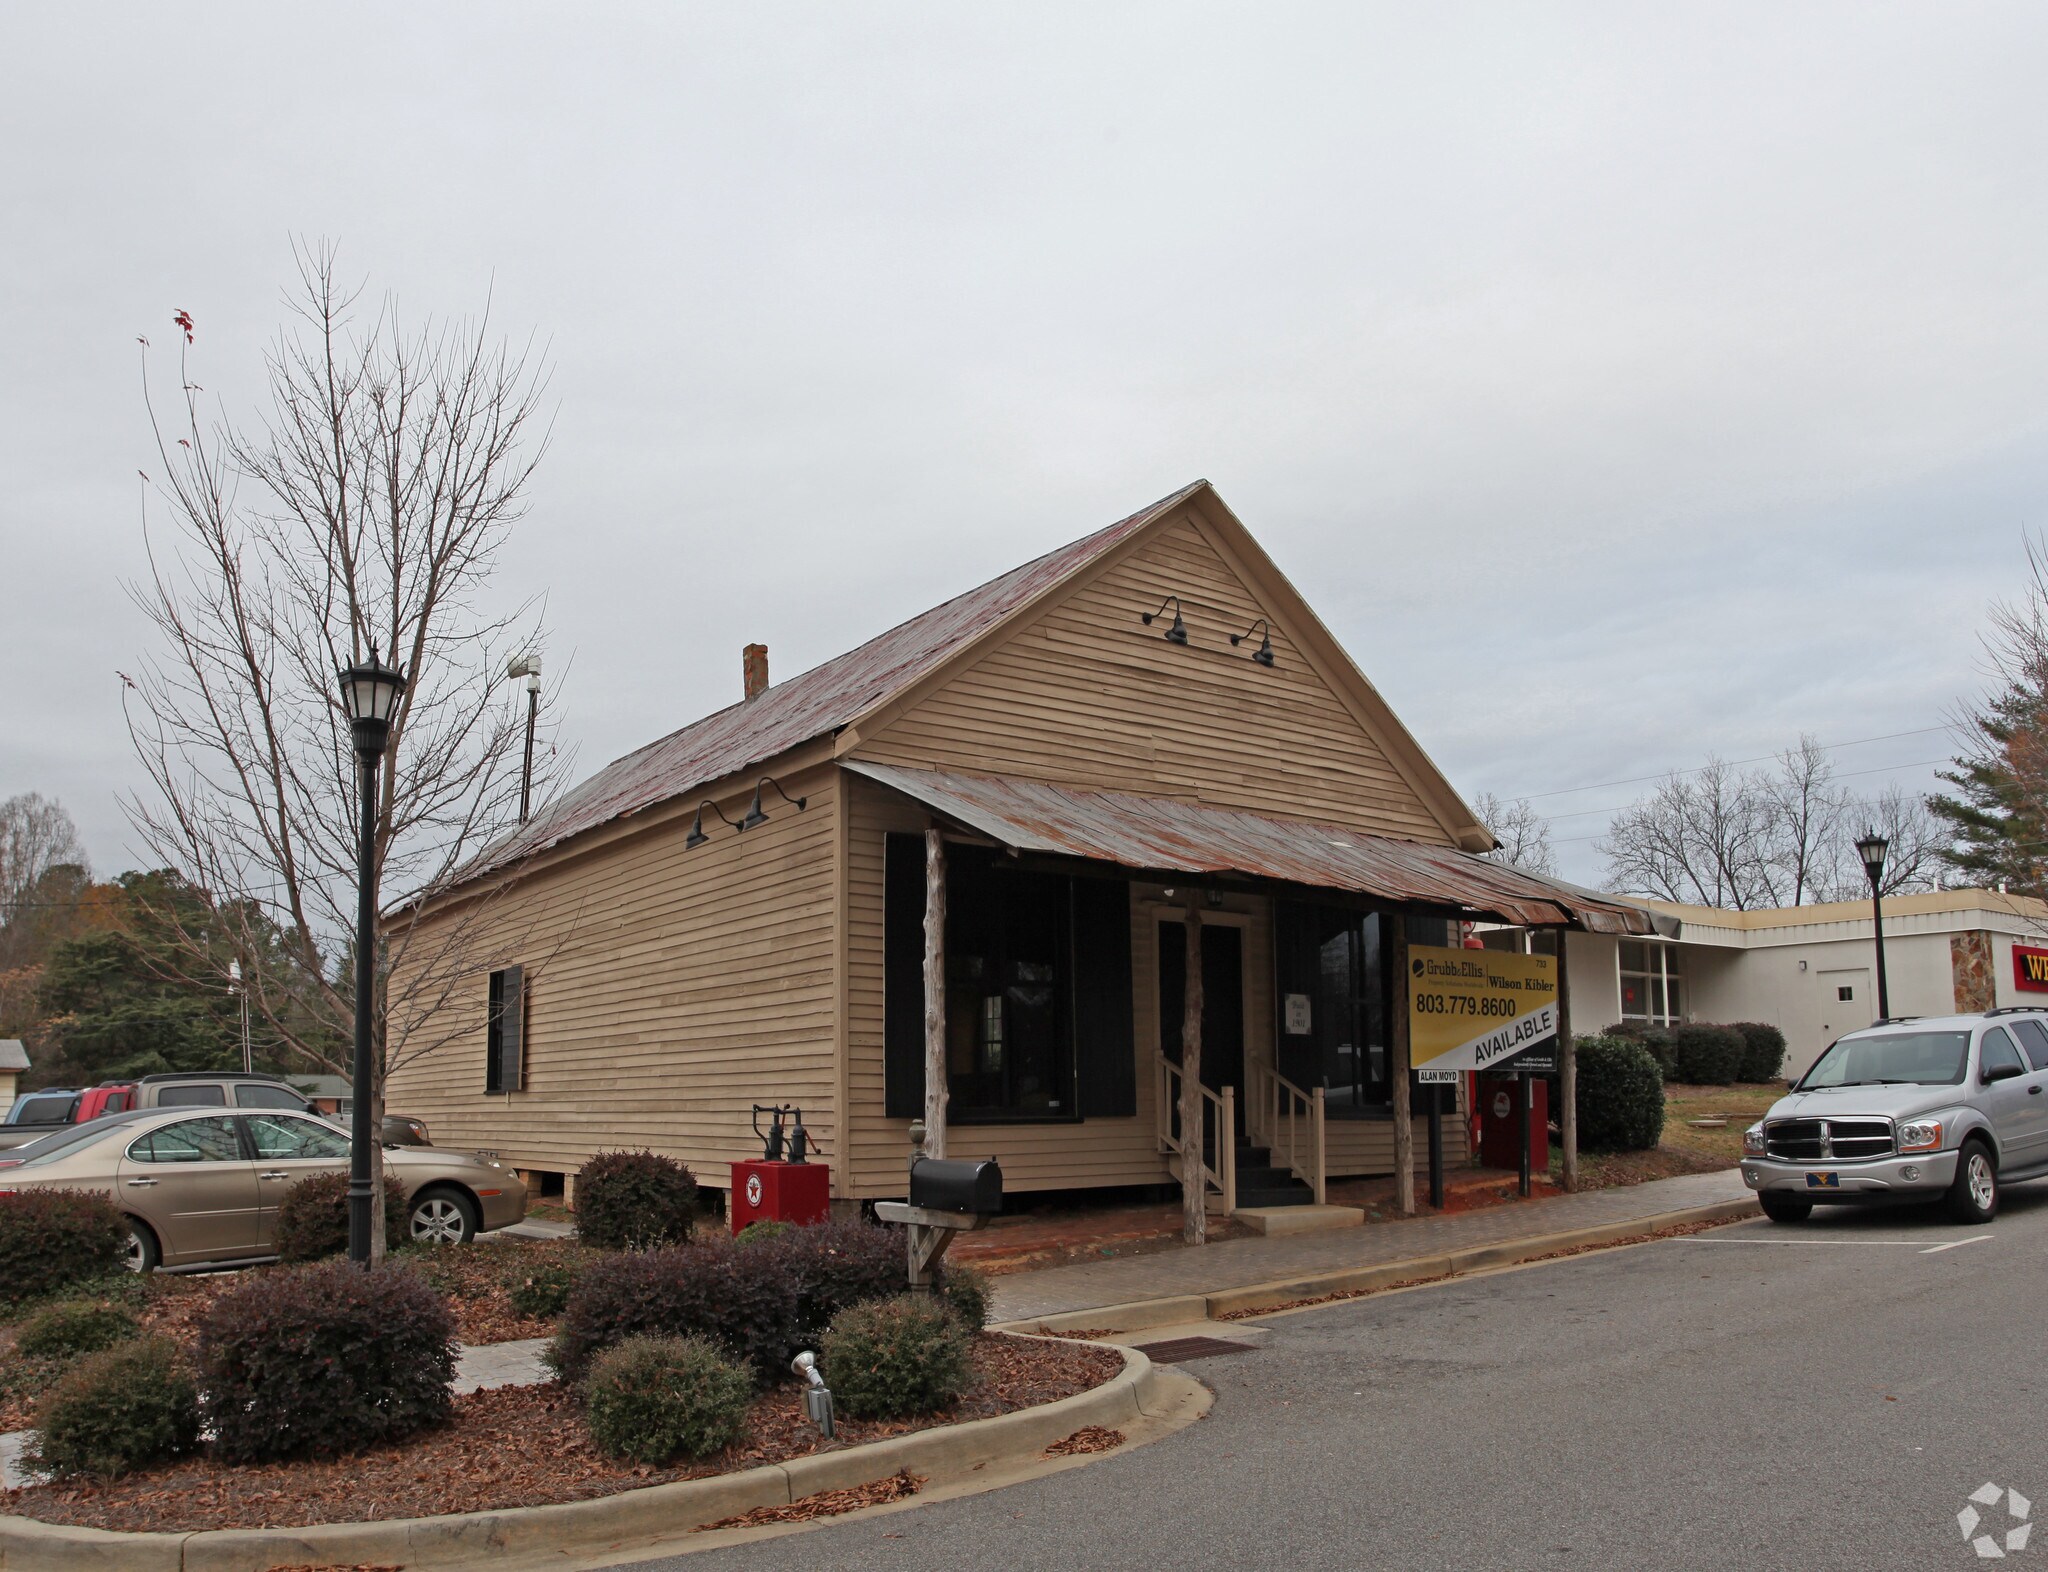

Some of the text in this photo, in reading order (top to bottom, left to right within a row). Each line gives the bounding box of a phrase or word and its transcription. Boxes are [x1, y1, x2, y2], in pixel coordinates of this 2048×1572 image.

[1535, 959, 1547, 969] 733
[1488, 976, 1522, 990] Wilson
[1524, 978, 1555, 992] Kibler
[1416, 993, 1517, 1017] 803.779.8600
[1475, 1010, 1552, 1065] AVAILABLE
[1420, 1071, 1457, 1081] ALAN MOYD
